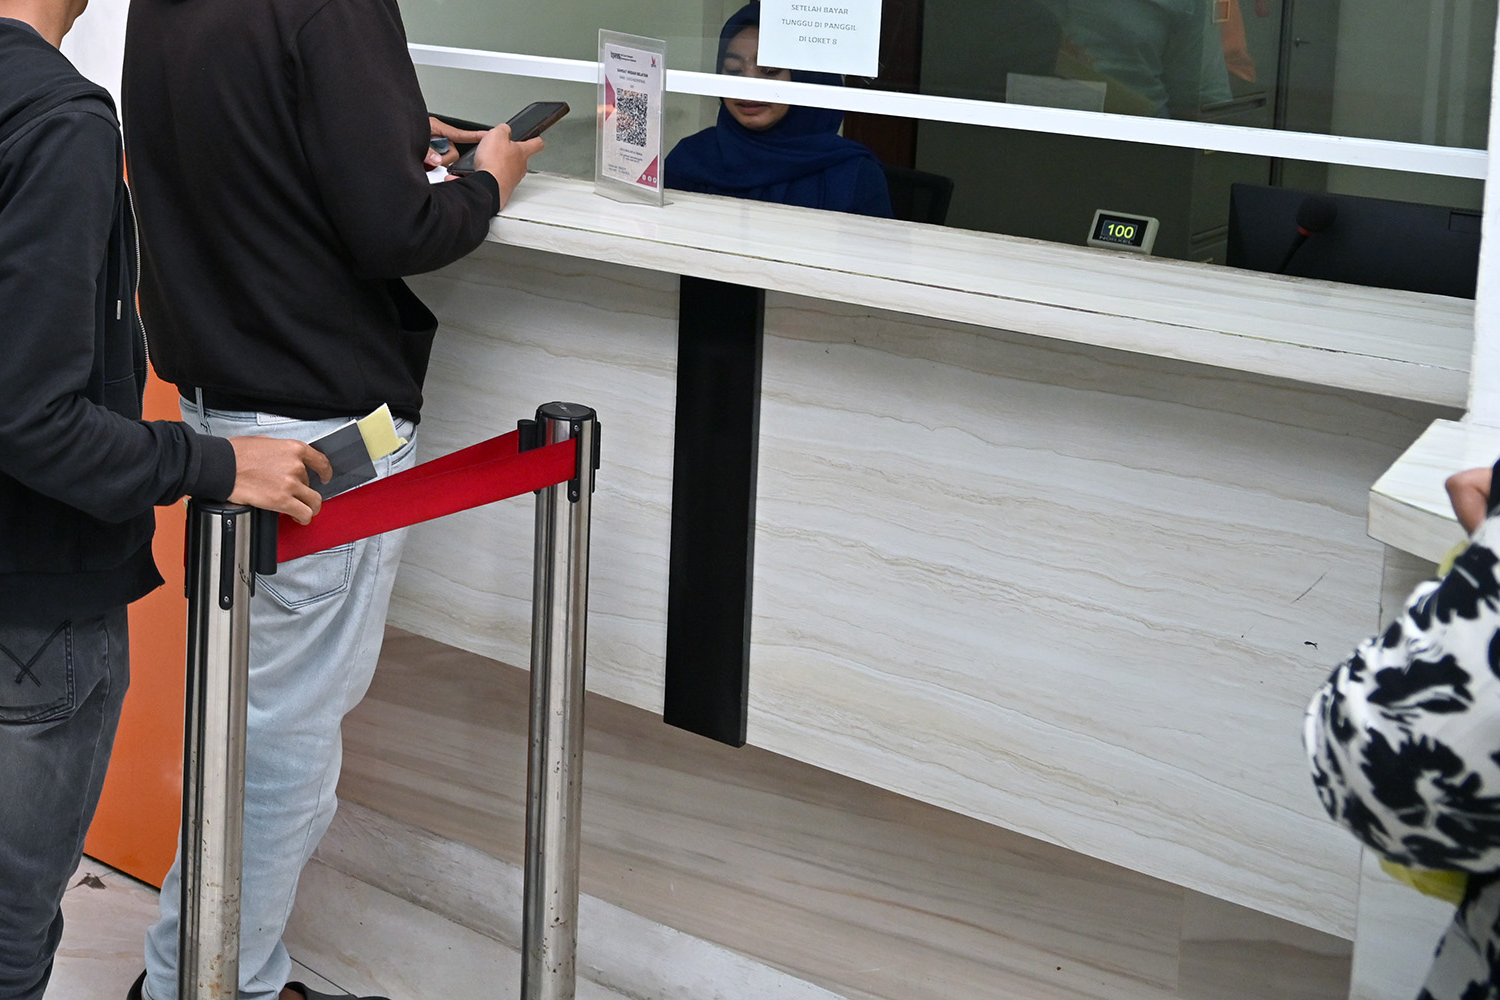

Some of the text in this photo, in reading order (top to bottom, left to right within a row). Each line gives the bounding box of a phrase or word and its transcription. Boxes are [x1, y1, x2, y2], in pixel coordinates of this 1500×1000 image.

[791, 4, 849, 15] SETELAH BAYAR
[781, 18, 857, 32] TUNGGU DI PANGGIL
[799, 35, 807, 43] DI
[808, 36, 831, 45] LOKET
[1108, 224, 1134, 239] 100
